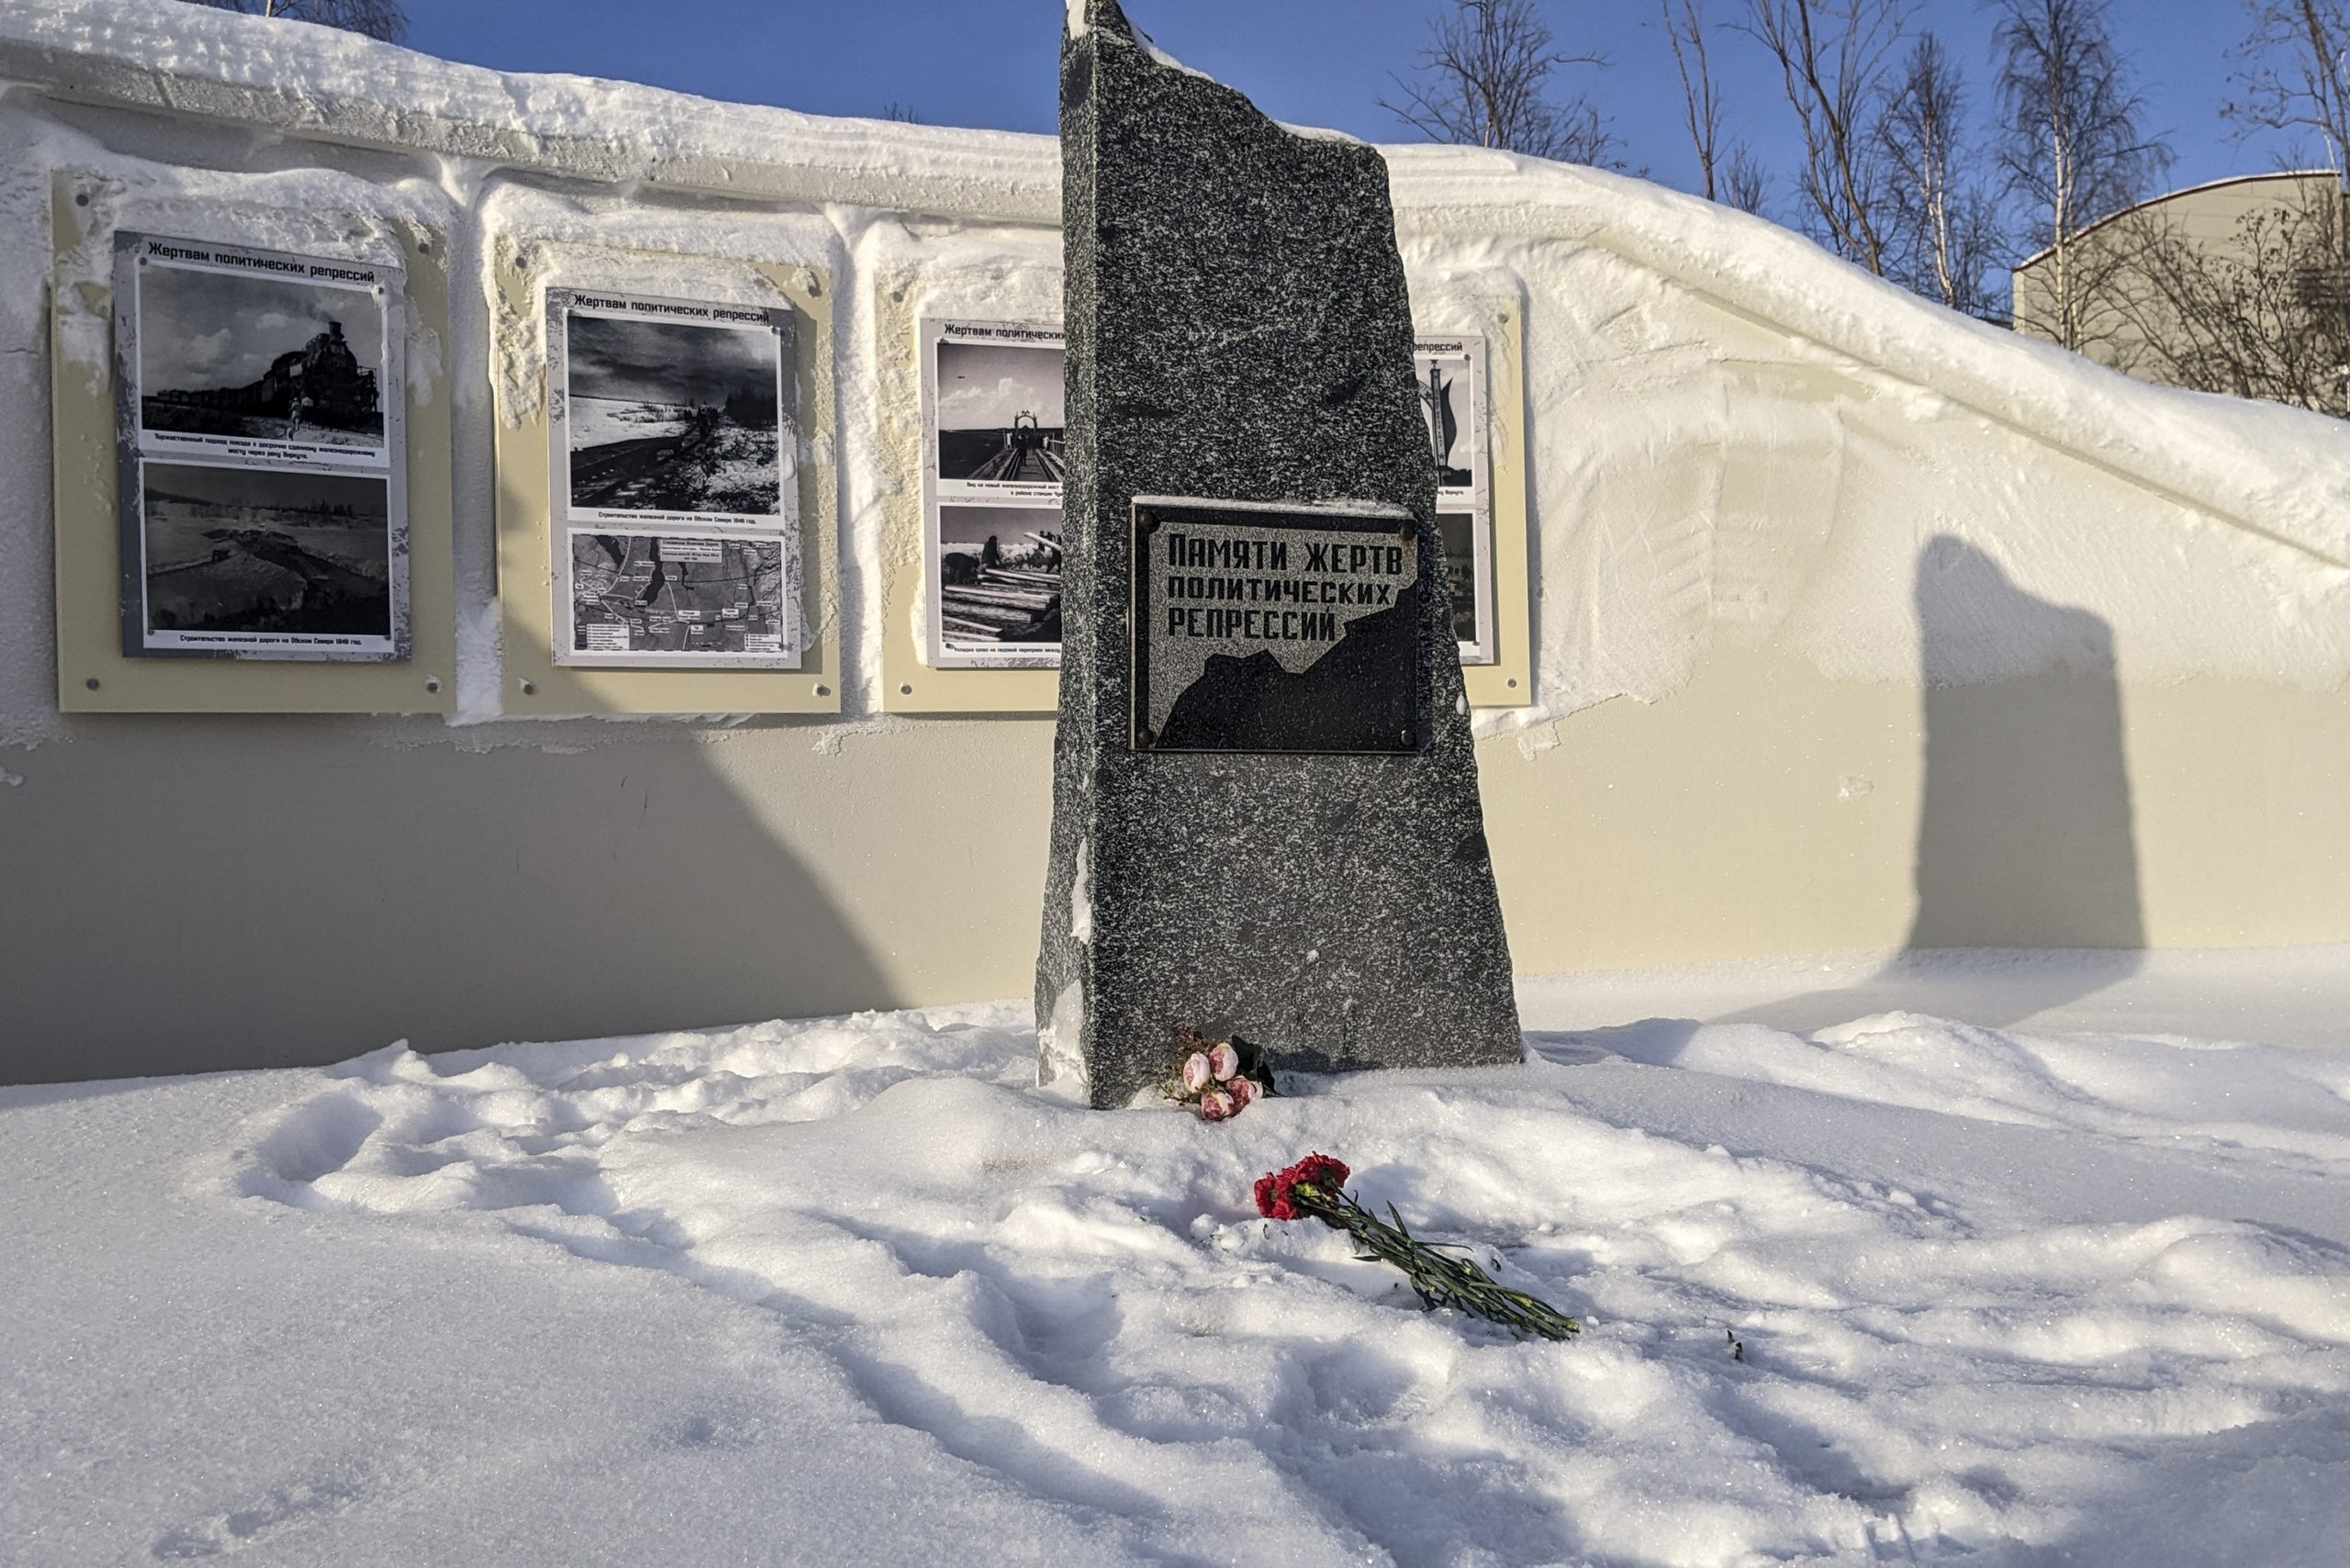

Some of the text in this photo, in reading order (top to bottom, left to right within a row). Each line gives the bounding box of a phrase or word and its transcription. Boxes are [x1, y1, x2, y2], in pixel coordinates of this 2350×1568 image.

[149, 241, 375, 283] Жертвам политических репрессий
[574, 294, 769, 323] Жертвам политических репрессий
[944, 323, 1065, 340] Жертвам политических
[1168, 533, 1403, 575] ПАМЯТИ ЖЕРТВ
[1168, 576, 1392, 605] ПОЛИТИЧЕСКИХ
[1168, 606, 1336, 642] РЕПРЕССИЙ
